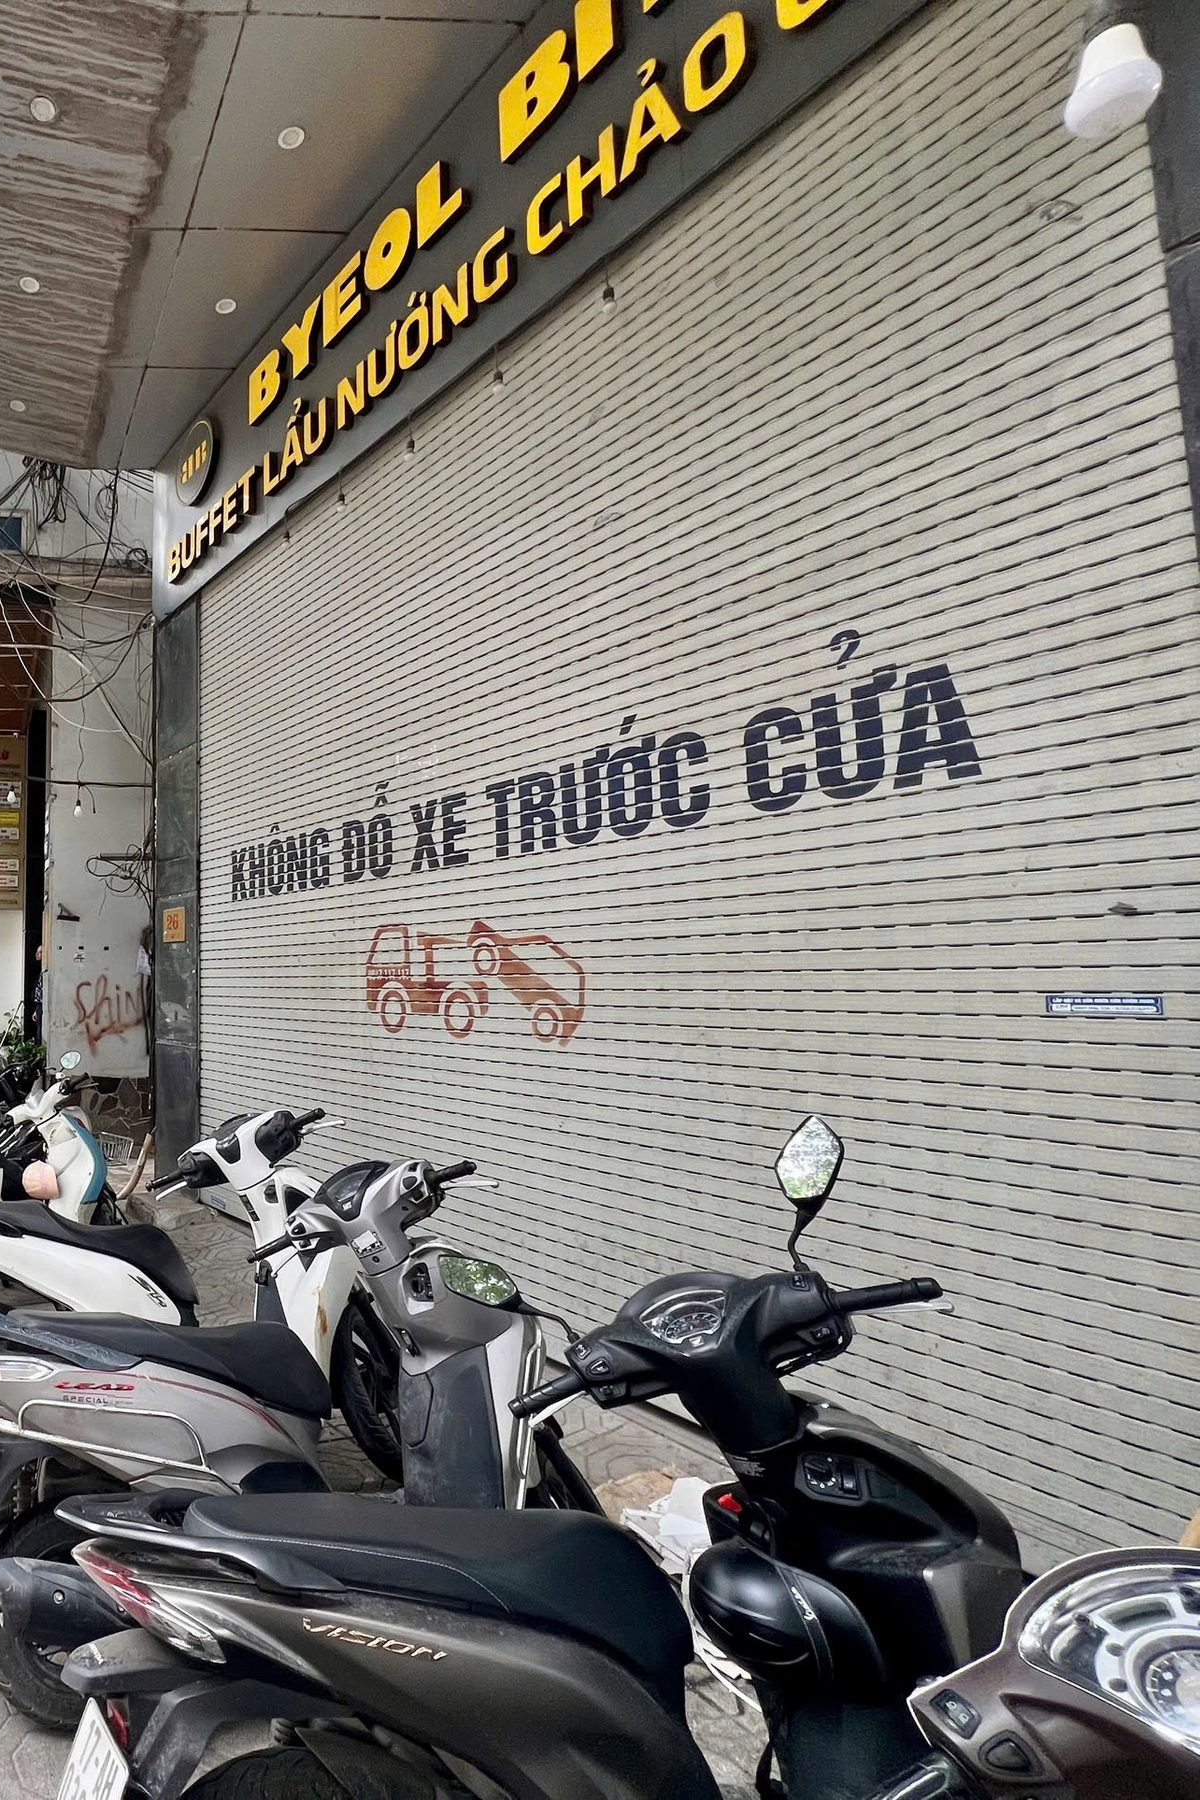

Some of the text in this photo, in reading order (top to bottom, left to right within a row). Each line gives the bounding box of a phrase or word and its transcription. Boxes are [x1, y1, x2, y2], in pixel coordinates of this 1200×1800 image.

[249, 0, 666, 425] BYEOL BI
[168, 11, 747, 584] BUFFET LẨU NƯỚNG CHẢO
[231, 629, 983, 900] KHÔNG ĐỖ XE TRƯỚC CỬA
[166, 914, 179, 930] 26
[54, 1381, 136, 1391] LEAD
[62, 1395, 109, 1405] SPECIAL
[302, 1617, 448, 1661] VISION
